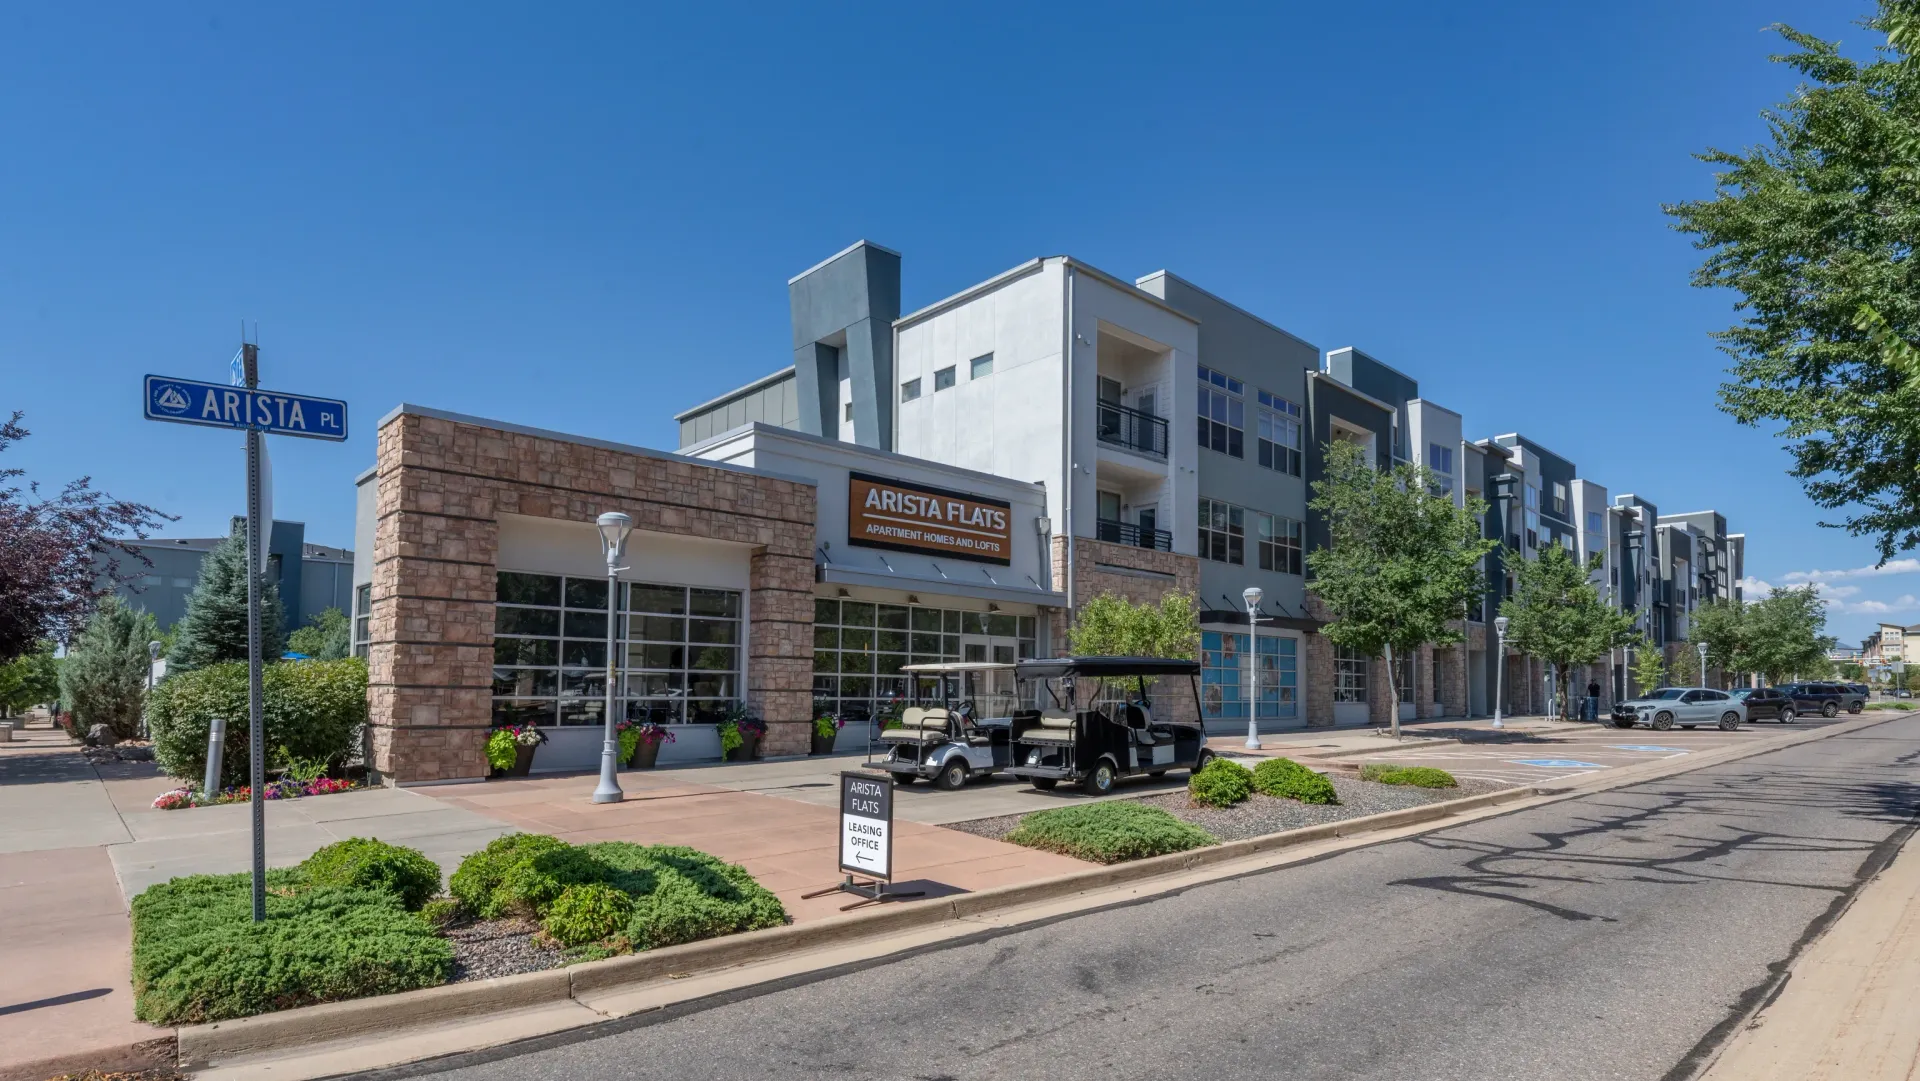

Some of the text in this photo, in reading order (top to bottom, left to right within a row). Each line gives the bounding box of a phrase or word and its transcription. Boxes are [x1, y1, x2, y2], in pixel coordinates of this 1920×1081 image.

[201, 389, 307, 430] ARISTA
[320, 412, 340, 428] PL
[864, 488, 1006, 530] ARISTA FLATS
[866, 524, 1000, 552] APARTMENT HOMES AND LOFTS
[850, 781, 882, 797] ARISTA
[852, 798, 879, 814] FLATS
[848, 821, 883, 837] LEASING
[851, 836, 879, 851] OFFICE
